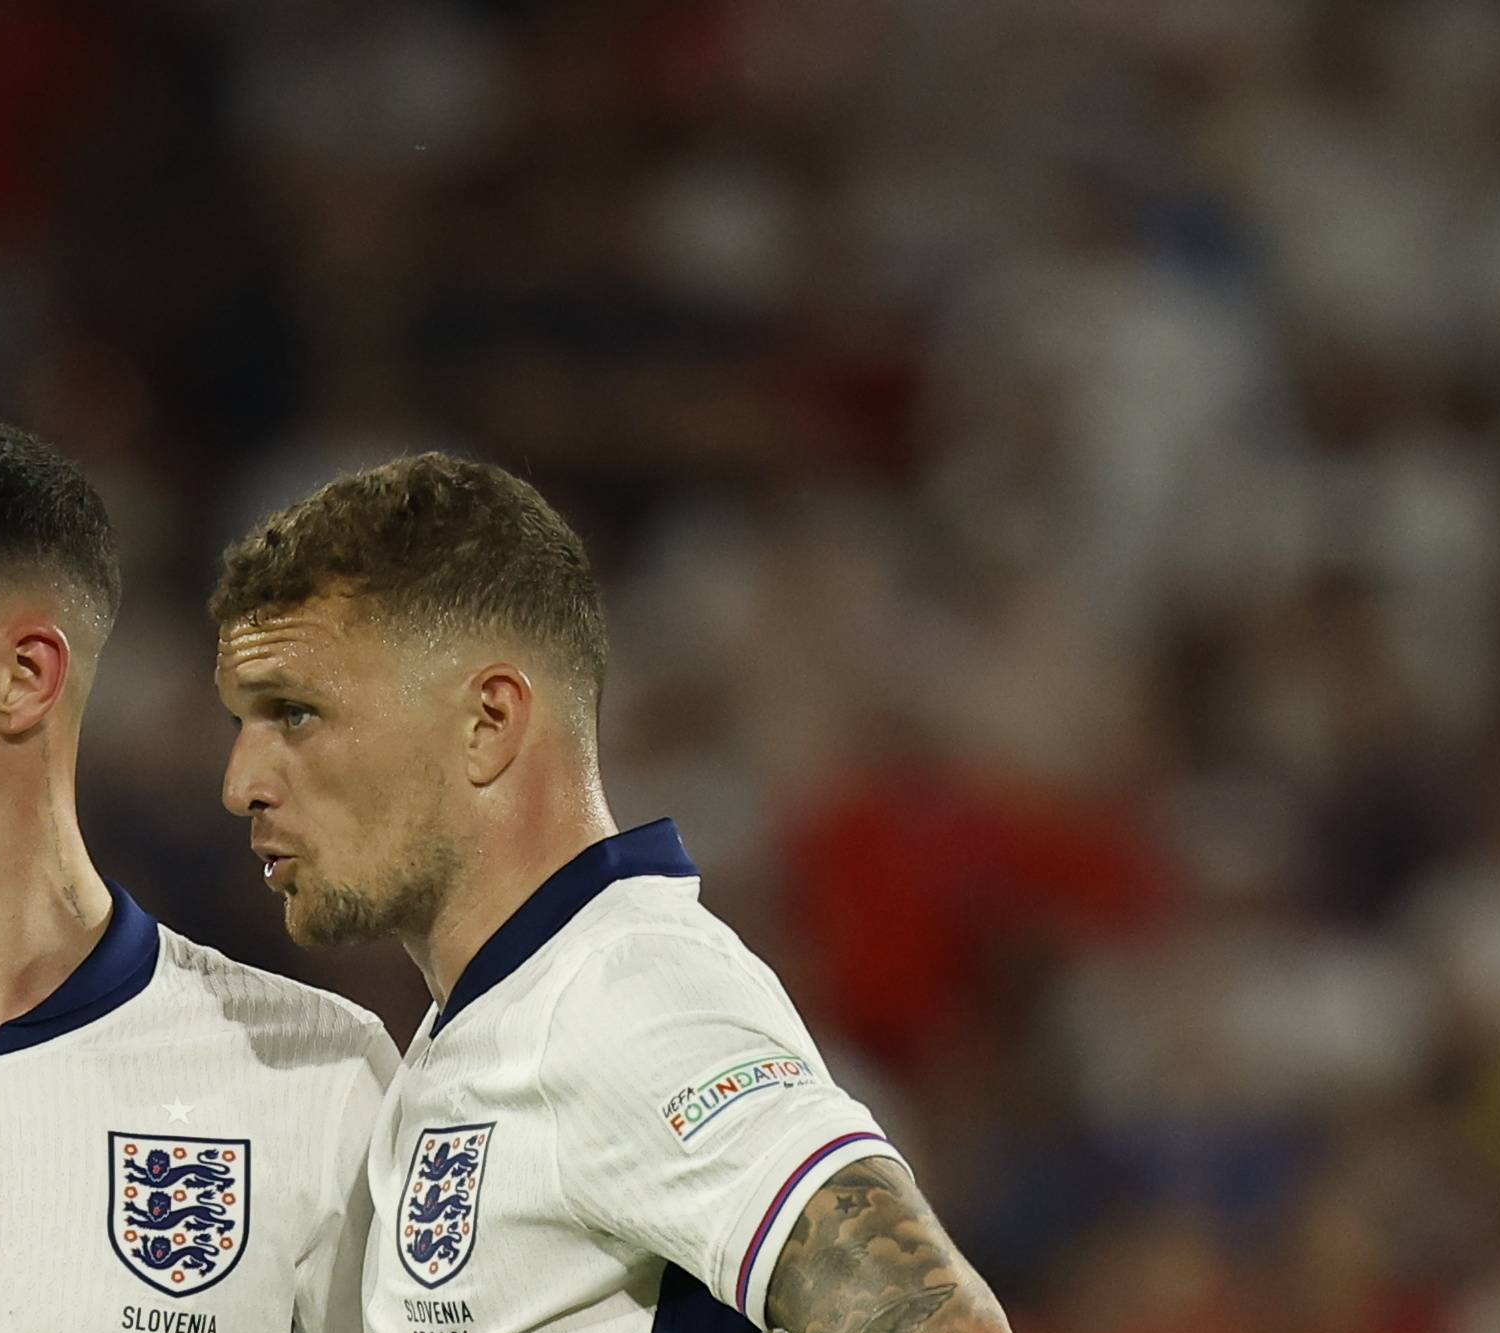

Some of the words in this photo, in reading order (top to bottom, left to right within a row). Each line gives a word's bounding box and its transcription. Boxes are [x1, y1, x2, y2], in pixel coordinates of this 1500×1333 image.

[661, 1085, 697, 1119] UEFA
[669, 1060, 814, 1137] FOUNDATION
[403, 1298, 475, 1325] SLOVENIA
